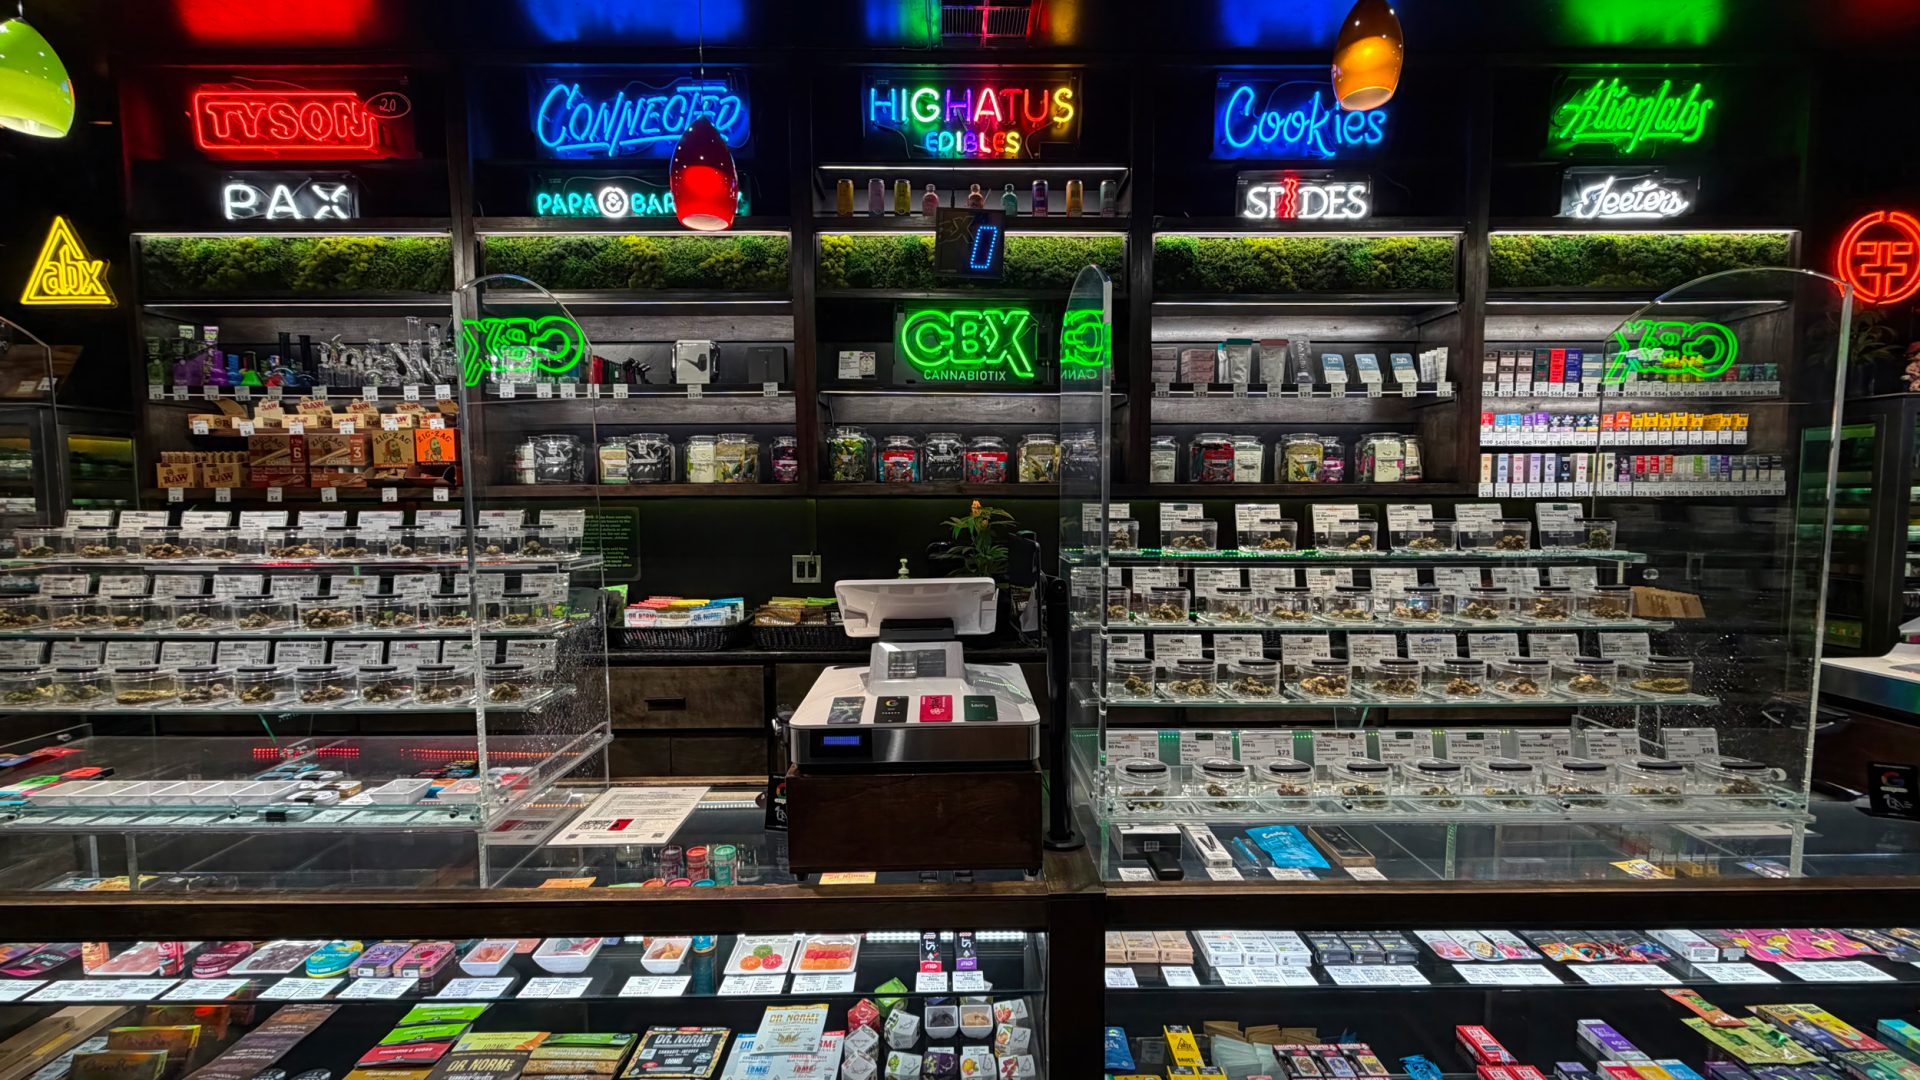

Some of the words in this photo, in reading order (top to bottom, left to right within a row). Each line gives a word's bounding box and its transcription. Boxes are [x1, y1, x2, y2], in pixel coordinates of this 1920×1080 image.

[871, 87, 1074, 126] HIGHATUS
[1560, 77, 1714, 154] Alienlabs
[205, 101, 370, 142] TYSON
[537, 83, 743, 157] CONNECTED
[1225, 85, 1387, 157] Cookies
[925, 131, 1020, 155] EDIBLES
[223, 184, 349, 219] PAX
[536, 192, 599, 216] PAPA
[902, 310, 1035, 379] CBX
[923, 369, 1007, 382] CANNABIOTIX
[293, 447, 302, 458] 6
[353, 447, 362, 458] 3
[163, 473, 188, 483] RAW
[209, 472, 234, 482] RAW
[446, 1059, 468, 1072] DR.
